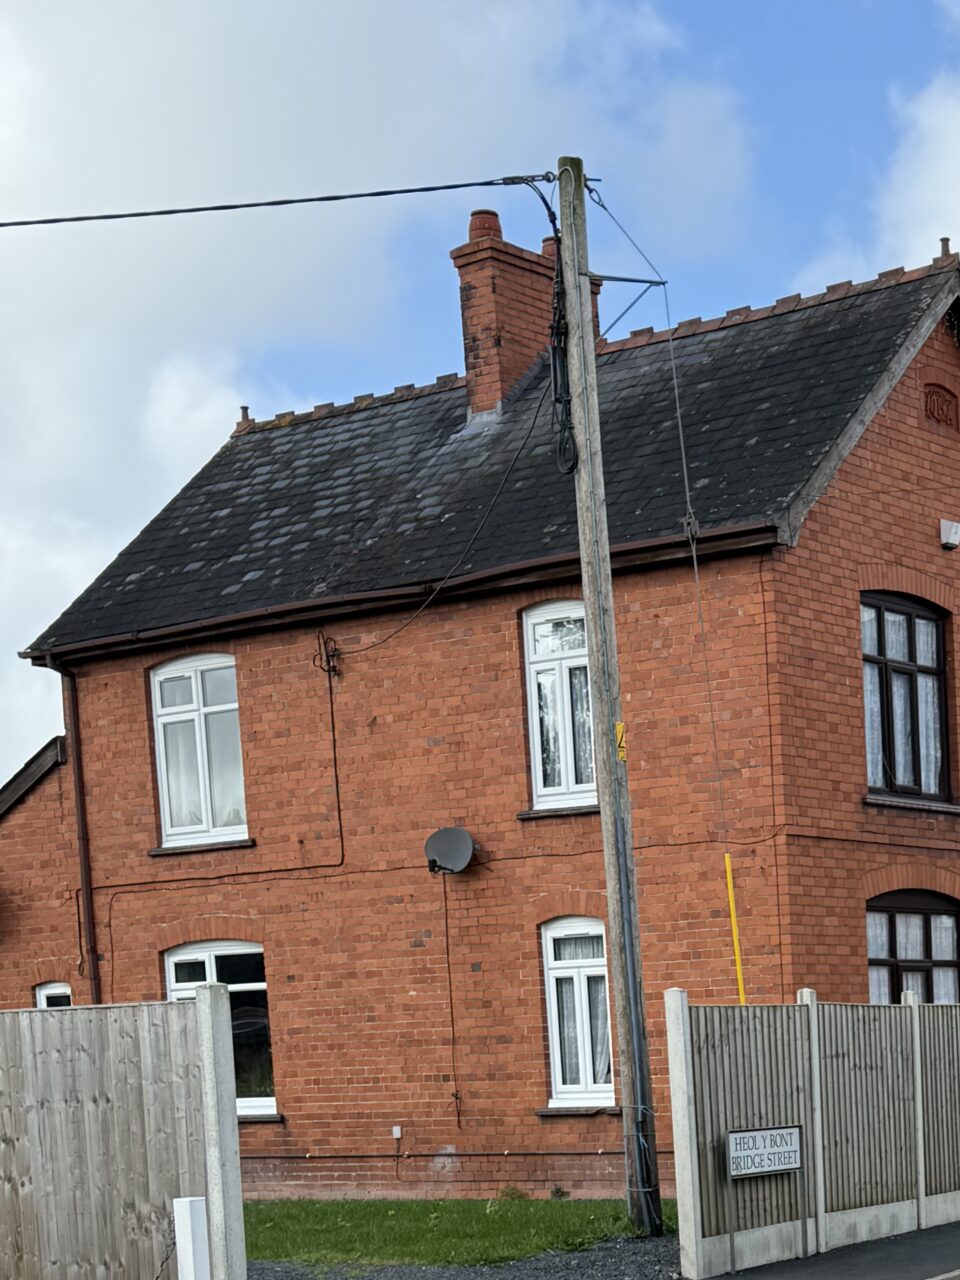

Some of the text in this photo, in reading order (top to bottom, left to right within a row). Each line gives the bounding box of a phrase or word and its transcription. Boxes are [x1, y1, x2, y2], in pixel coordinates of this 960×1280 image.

[735, 1132, 794, 1152] HEOL Y BONT
[731, 1150, 798, 1171] BRIDGE STREET
